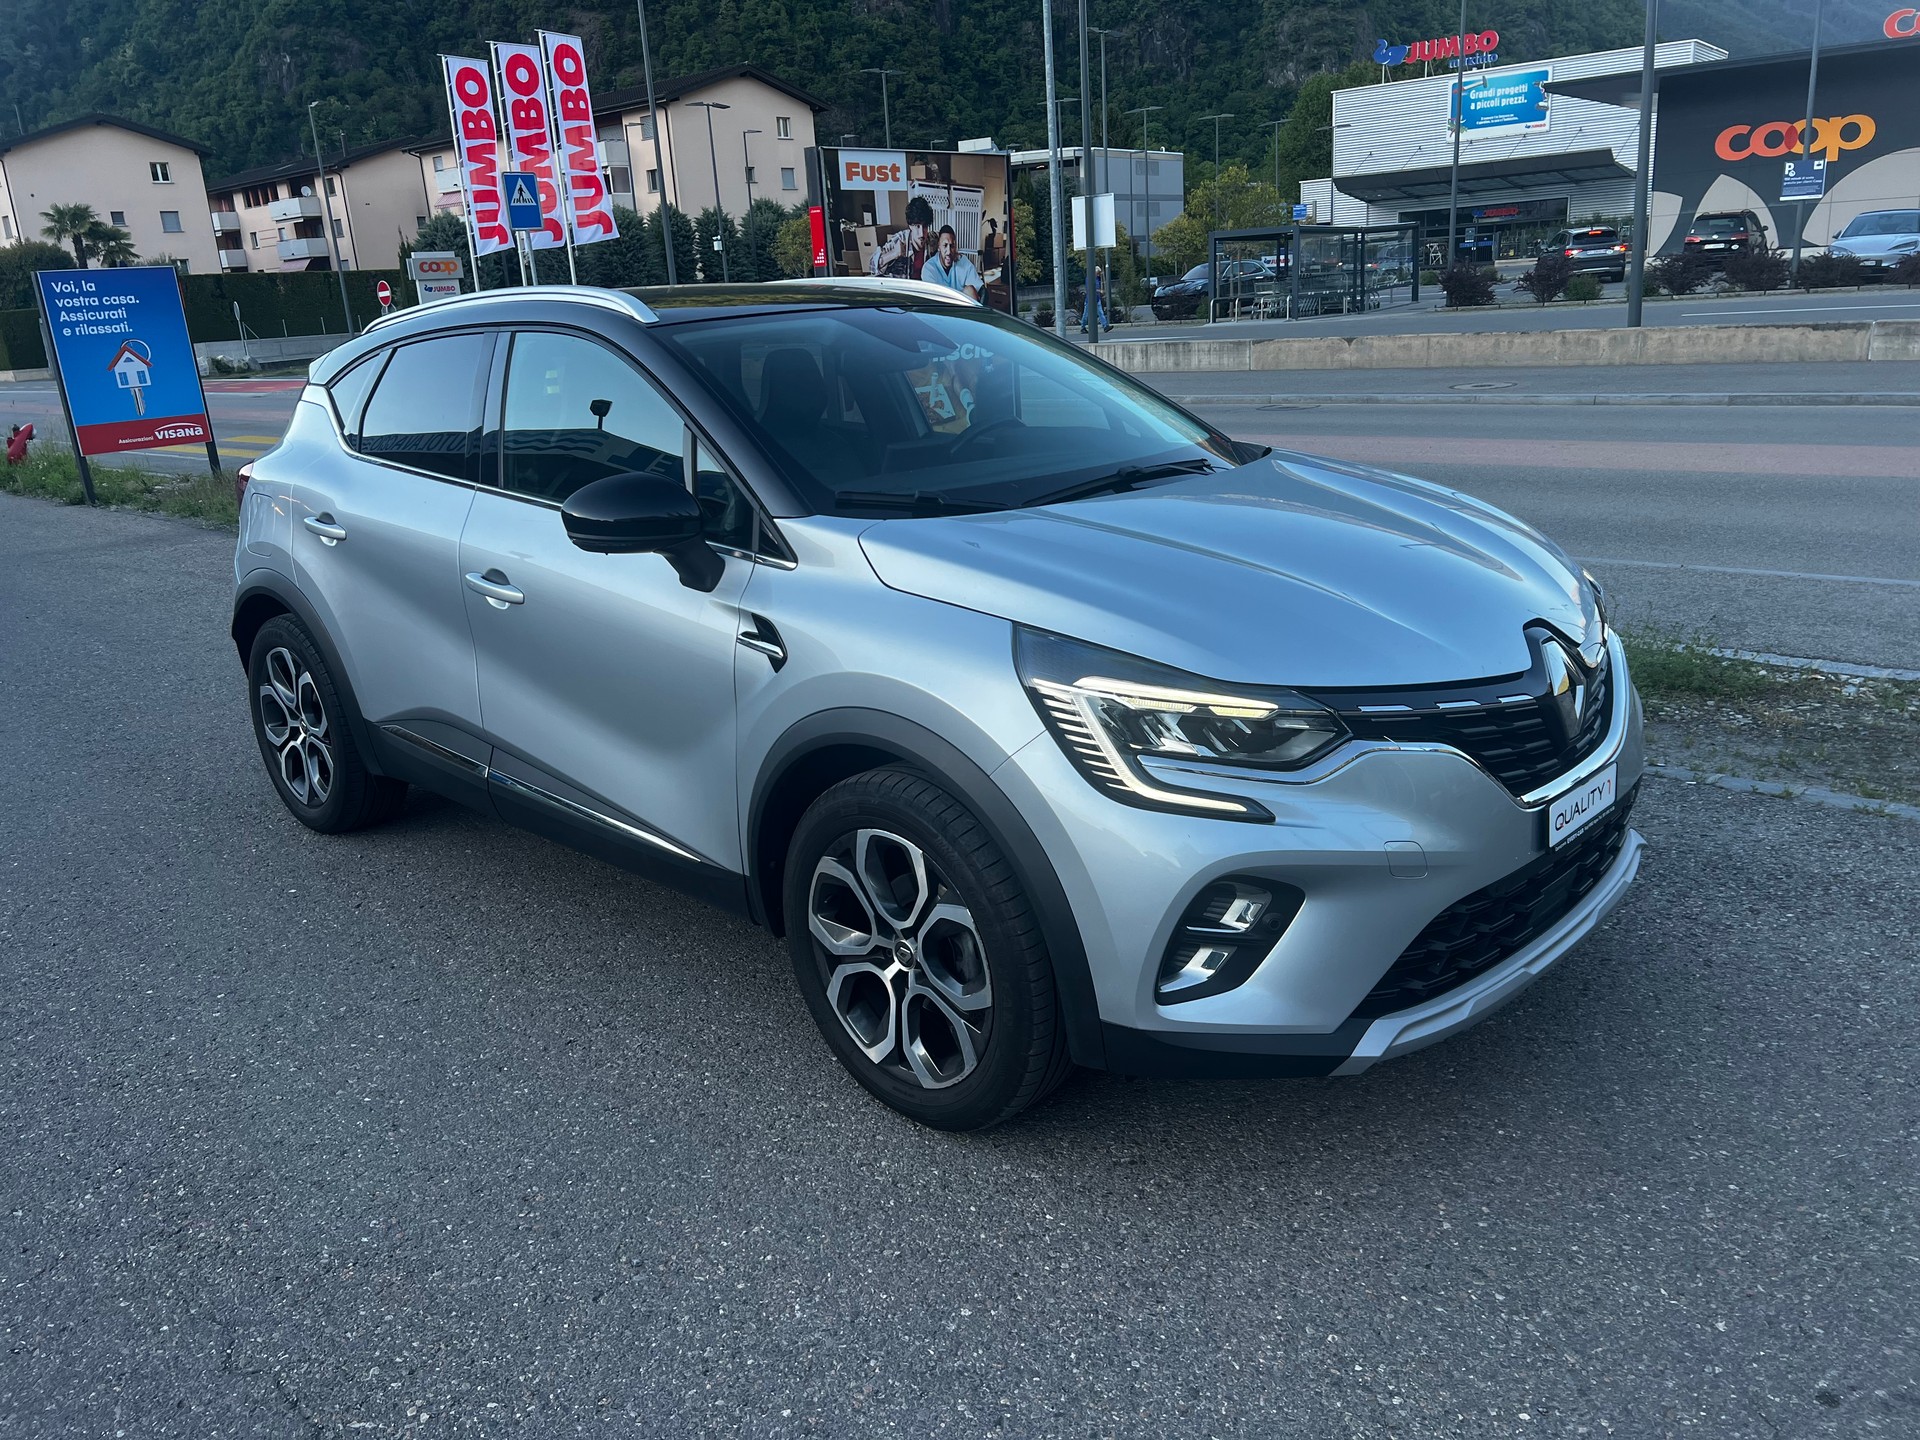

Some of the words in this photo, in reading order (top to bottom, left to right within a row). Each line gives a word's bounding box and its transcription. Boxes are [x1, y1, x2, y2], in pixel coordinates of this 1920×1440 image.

[1405, 30, 1499, 64] JUMBO
[1469, 87, 1496, 100] Grandi
[1497, 83, 1528, 97] progetti
[1470, 102, 1475, 110] a
[1476, 98, 1500, 111] piccoli
[1501, 95, 1528, 107] prezzi.
[553, 43, 613, 235] JUMBO
[1714, 114, 1876, 161] coop
[455, 66, 508, 245] JUMBO
[845, 162, 900, 182] Fust
[1784, 162, 1794, 175] P
[419, 260, 458, 275] coop
[51, 280, 79, 294] Voi,
[81, 280, 96, 292] la
[433, 285, 456, 293] JUMBO
[55, 296, 99, 308] vostra
[102, 295, 140, 305] casa.
[60, 307, 127, 322] Assicurati
[63, 327, 71, 336] e
[75, 321, 133, 336] rilassati.
[118, 435, 154, 444] Assicurazioni
